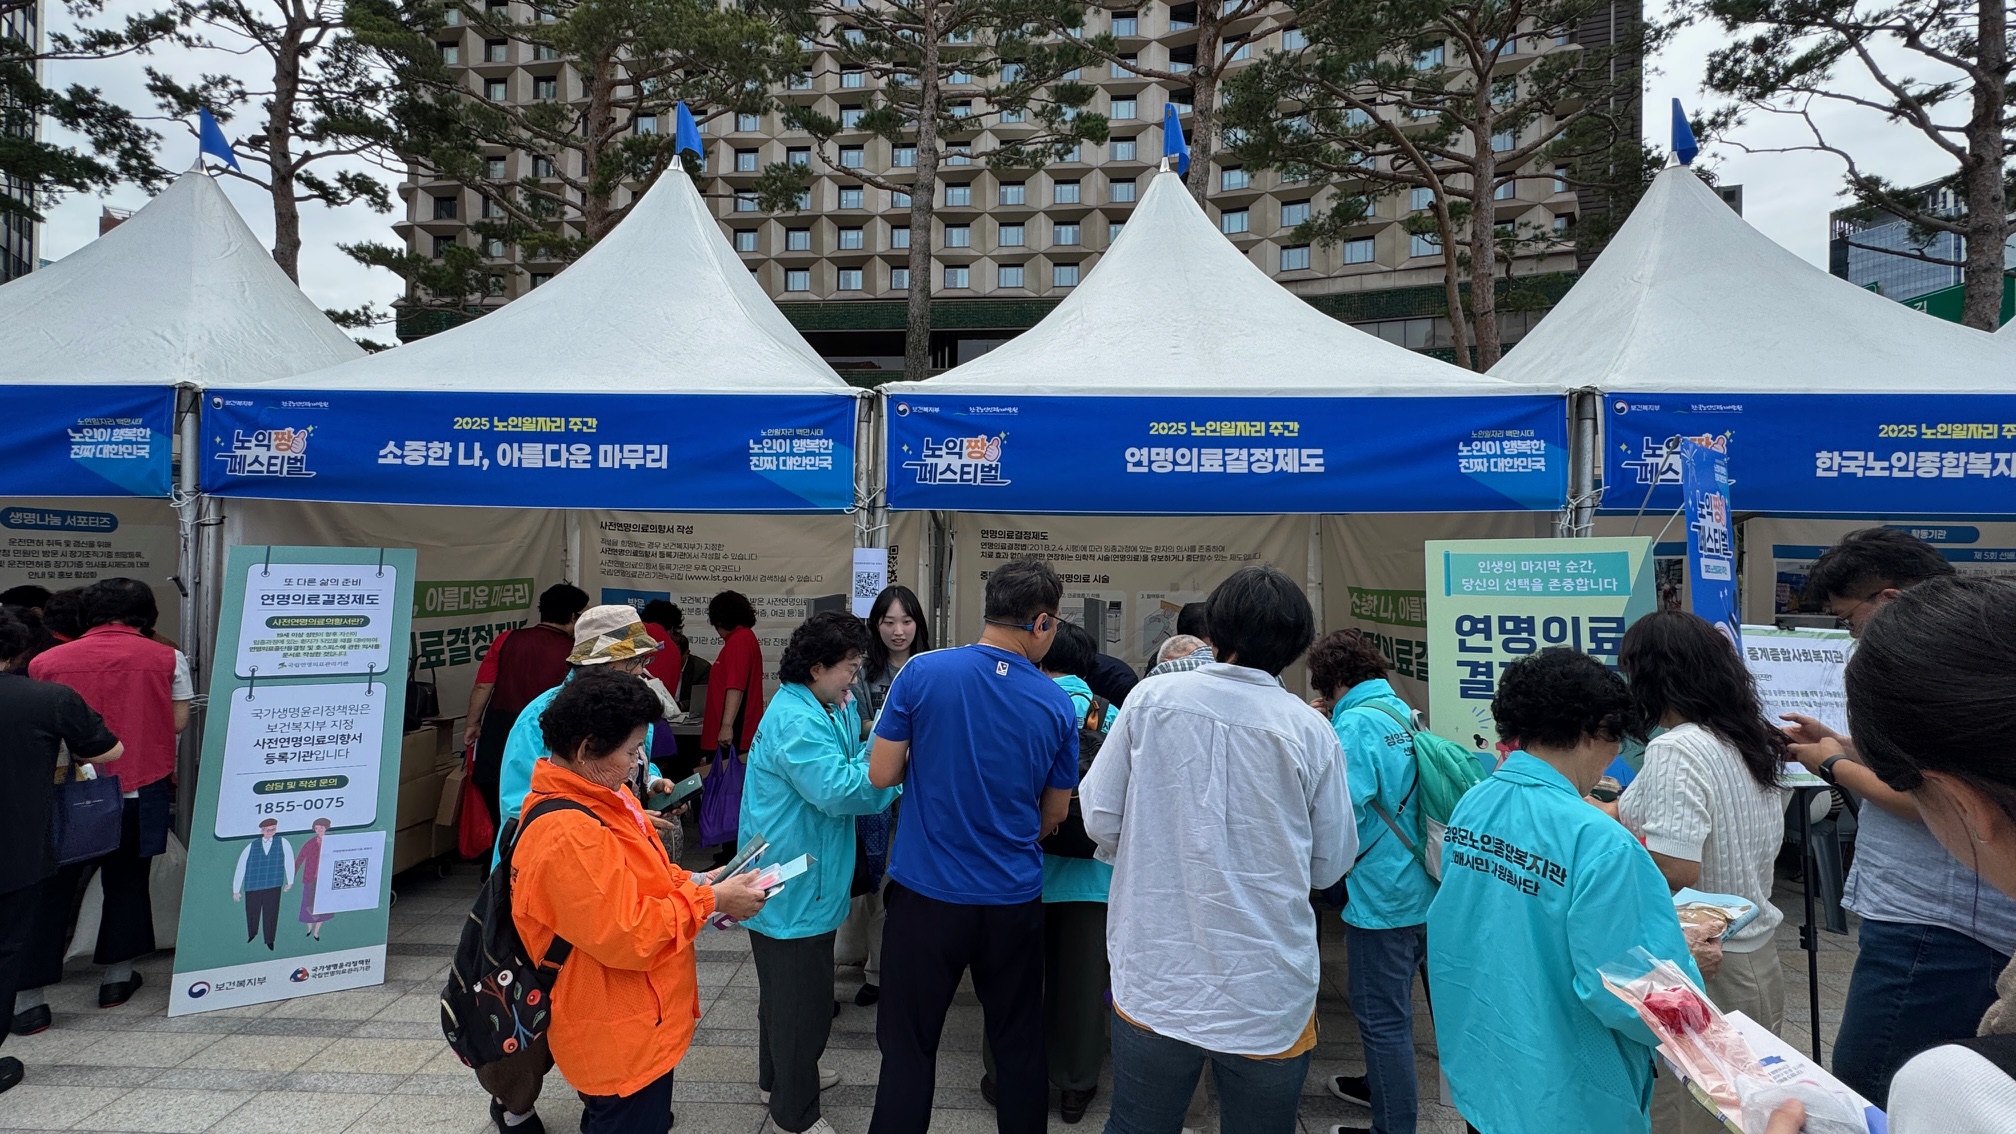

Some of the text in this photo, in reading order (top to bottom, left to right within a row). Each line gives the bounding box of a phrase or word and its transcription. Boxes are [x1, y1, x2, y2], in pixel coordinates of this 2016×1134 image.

[453, 417, 597, 432] 2025 노인일자리 주간
[760, 428, 824, 436] 노인일자리 백만시대
[1149, 421, 1299, 437] 2025 노인일자리 주간
[1878, 424, 1917, 438] 2025
[1921, 423, 1998, 439] 노인일자리
[67, 428, 151, 442] 노인이 행복한
[233, 428, 293, 452] 노익짱
[70, 445, 150, 458] 진짜 대한민국
[749, 439, 834, 453] 노인이 행복한
[923, 437, 987, 460] 노익짱
[1458, 439, 1546, 456] 노인이 행복한
[378, 441, 668, 471] 소중한 나, 아름다운 마무리
[749, 456, 833, 471] 진짜 대한민국
[1124, 447, 1325, 474] 연명의료결정제도
[216, 454, 315, 476] 페스티벌
[1458, 457, 1546, 473] 진짜 대한민국
[903, 462, 1011, 484] 페스티벌
[9, 511, 111, 528] 생명나눔 서포터즈
[600, 521, 693, 535] 사전연명의료의향서 작성
[980, 529, 1049, 540] 연명의료결정제도
[8, 538, 44, 547] 운전면허
[621, 539, 645, 549] 희망하는
[647, 541, 662, 549] 경우
[663, 542, 703, 551] 보건복지부가
[704, 543, 725, 552] 지정한
[1691, 522, 1733, 558] 페스티벌
[13, 549, 40, 558] 민원인
[42, 550, 58, 558] 방문
[60, 550, 67, 558] 시
[600, 547, 657, 558] 사전연명의료의향서
[658, 551, 699, 560] 등록기관에서
[701, 552, 721, 560] 작성할
[980, 551, 994, 559] 치료
[1047, 553, 1073, 561] 연장하는
[1075, 554, 1096, 562] 의학적
[1097, 554, 1149, 562] 시술(연명의료)을
[1150, 554, 1184, 562] 유보하거나
[1214, 554, 1228, 562] 있는
[1104, 545, 1137, 553] 임종과정에
[1139, 545, 1152, 553] 있는
[1154, 545, 1175, 553] 환자의
[1176, 545, 1197, 553] 의사를
[1198, 545, 1225, 553] 존중하여
[7, 560, 51, 569] 운전면허증
[53, 560, 84, 569] 장기기증
[658, 563, 693, 572] 등록기관은
[694, 564, 708, 572] 우측
[709, 565, 741, 573] QR코드나
[1477, 560, 1597, 575] 인생의 마지막 순간,
[28, 571, 46, 579] 안내
[47, 571, 55, 579] 및
[284, 578, 361, 587] 또 다른 삶의 준비
[760, 575, 786, 583] 검색하실
[788, 575, 795, 583] 수
[1092, 574, 1110, 584] 시술
[1461, 577, 1618, 592] 당신의 선택을 존중합니다
[261, 593, 380, 606] 연명의료결정제도
[426, 586, 489, 612] 아름다운
[490, 583, 529, 607] 마무리
[771, 609, 805, 618] 여권 등)을
[1379, 595, 1396, 623] 나,
[272, 617, 364, 626] 사전연명의료의향서란?
[1455, 614, 1625, 656] 연명의료
[1747, 647, 1844, 664] 중계종합사회복지관
[251, 704, 371, 720] 국가생명윤리정책원은
[266, 719, 354, 734] 보건복지부 지정
[253, 733, 363, 750] 사전연명의료의향서
[264, 748, 349, 765] 등록기관입니다
[264, 778, 338, 791] 상담 및 작성 문의
[255, 797, 344, 815] 1855-0075
[311, 958, 371, 972] 국가생명윤리정책원
[311, 965, 371, 979] 국립연명의료관리기관
[215, 976, 267, 992] 보건복지부
